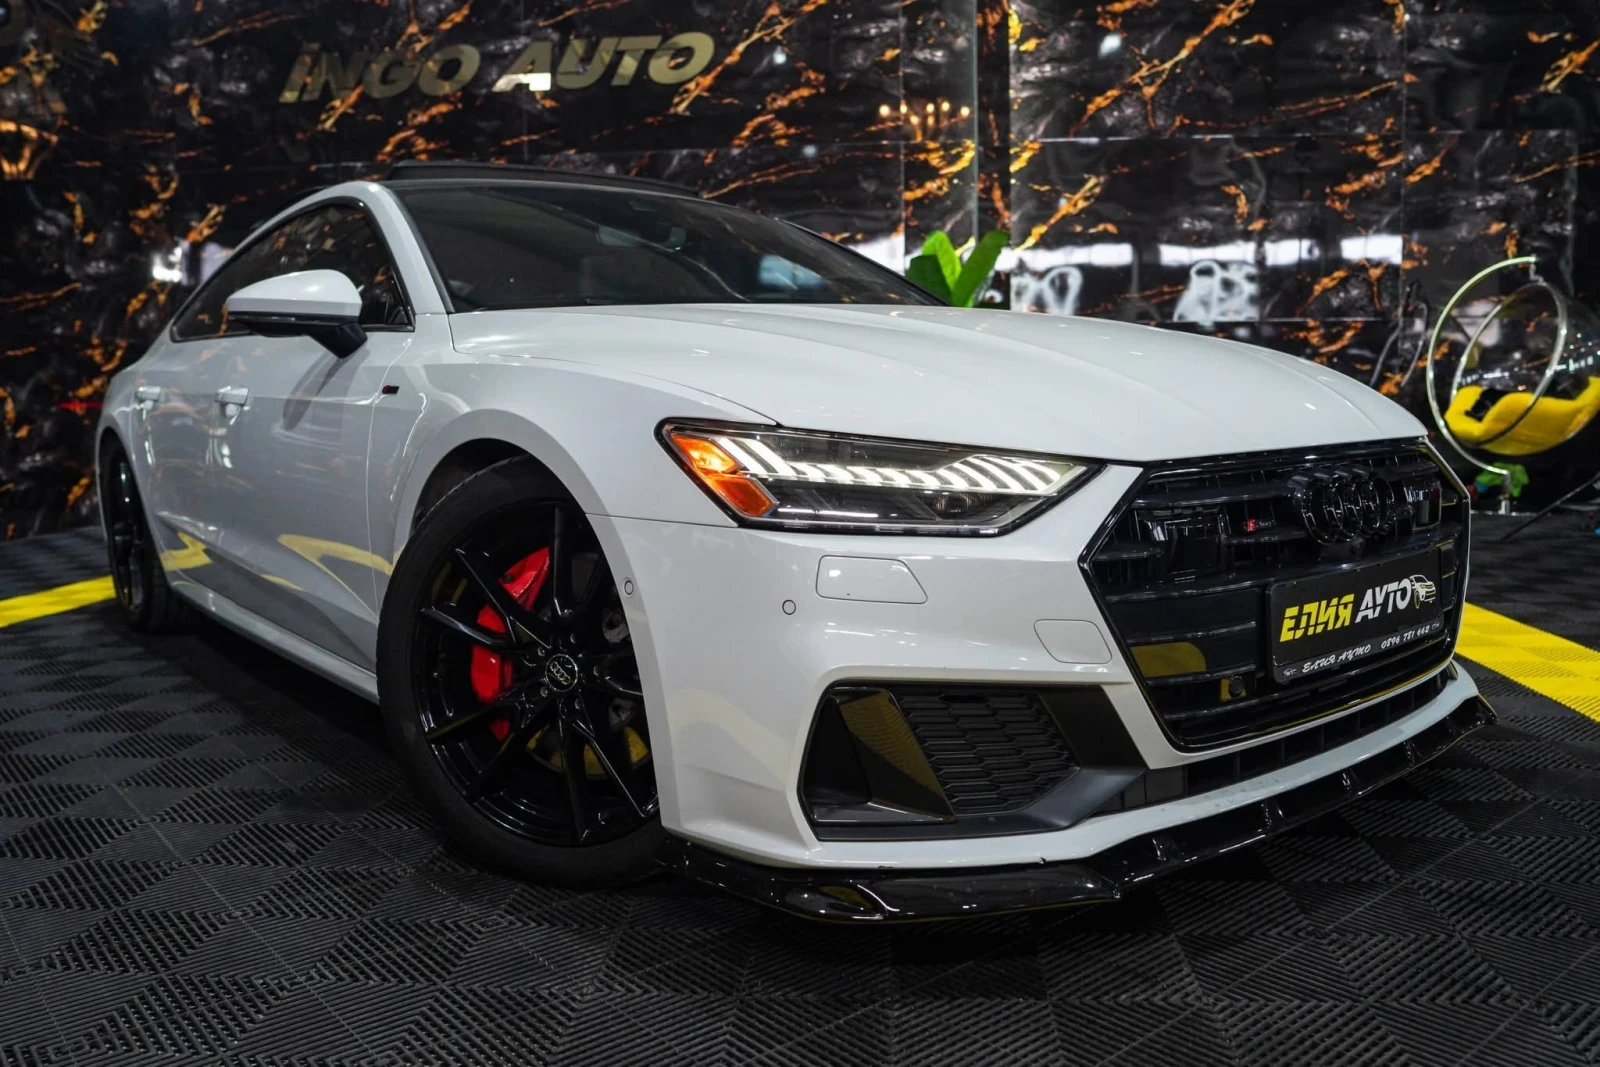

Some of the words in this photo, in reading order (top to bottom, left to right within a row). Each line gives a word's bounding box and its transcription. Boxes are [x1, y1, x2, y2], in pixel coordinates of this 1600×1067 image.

[278, 41, 482, 103] INGO
[491, 32, 715, 92] AUTO
[1279, 593, 1355, 643] ЕЛИЯ
[1355, 578, 1412, 624] АУТО
[1380, 635, 1401, 650] 0896
